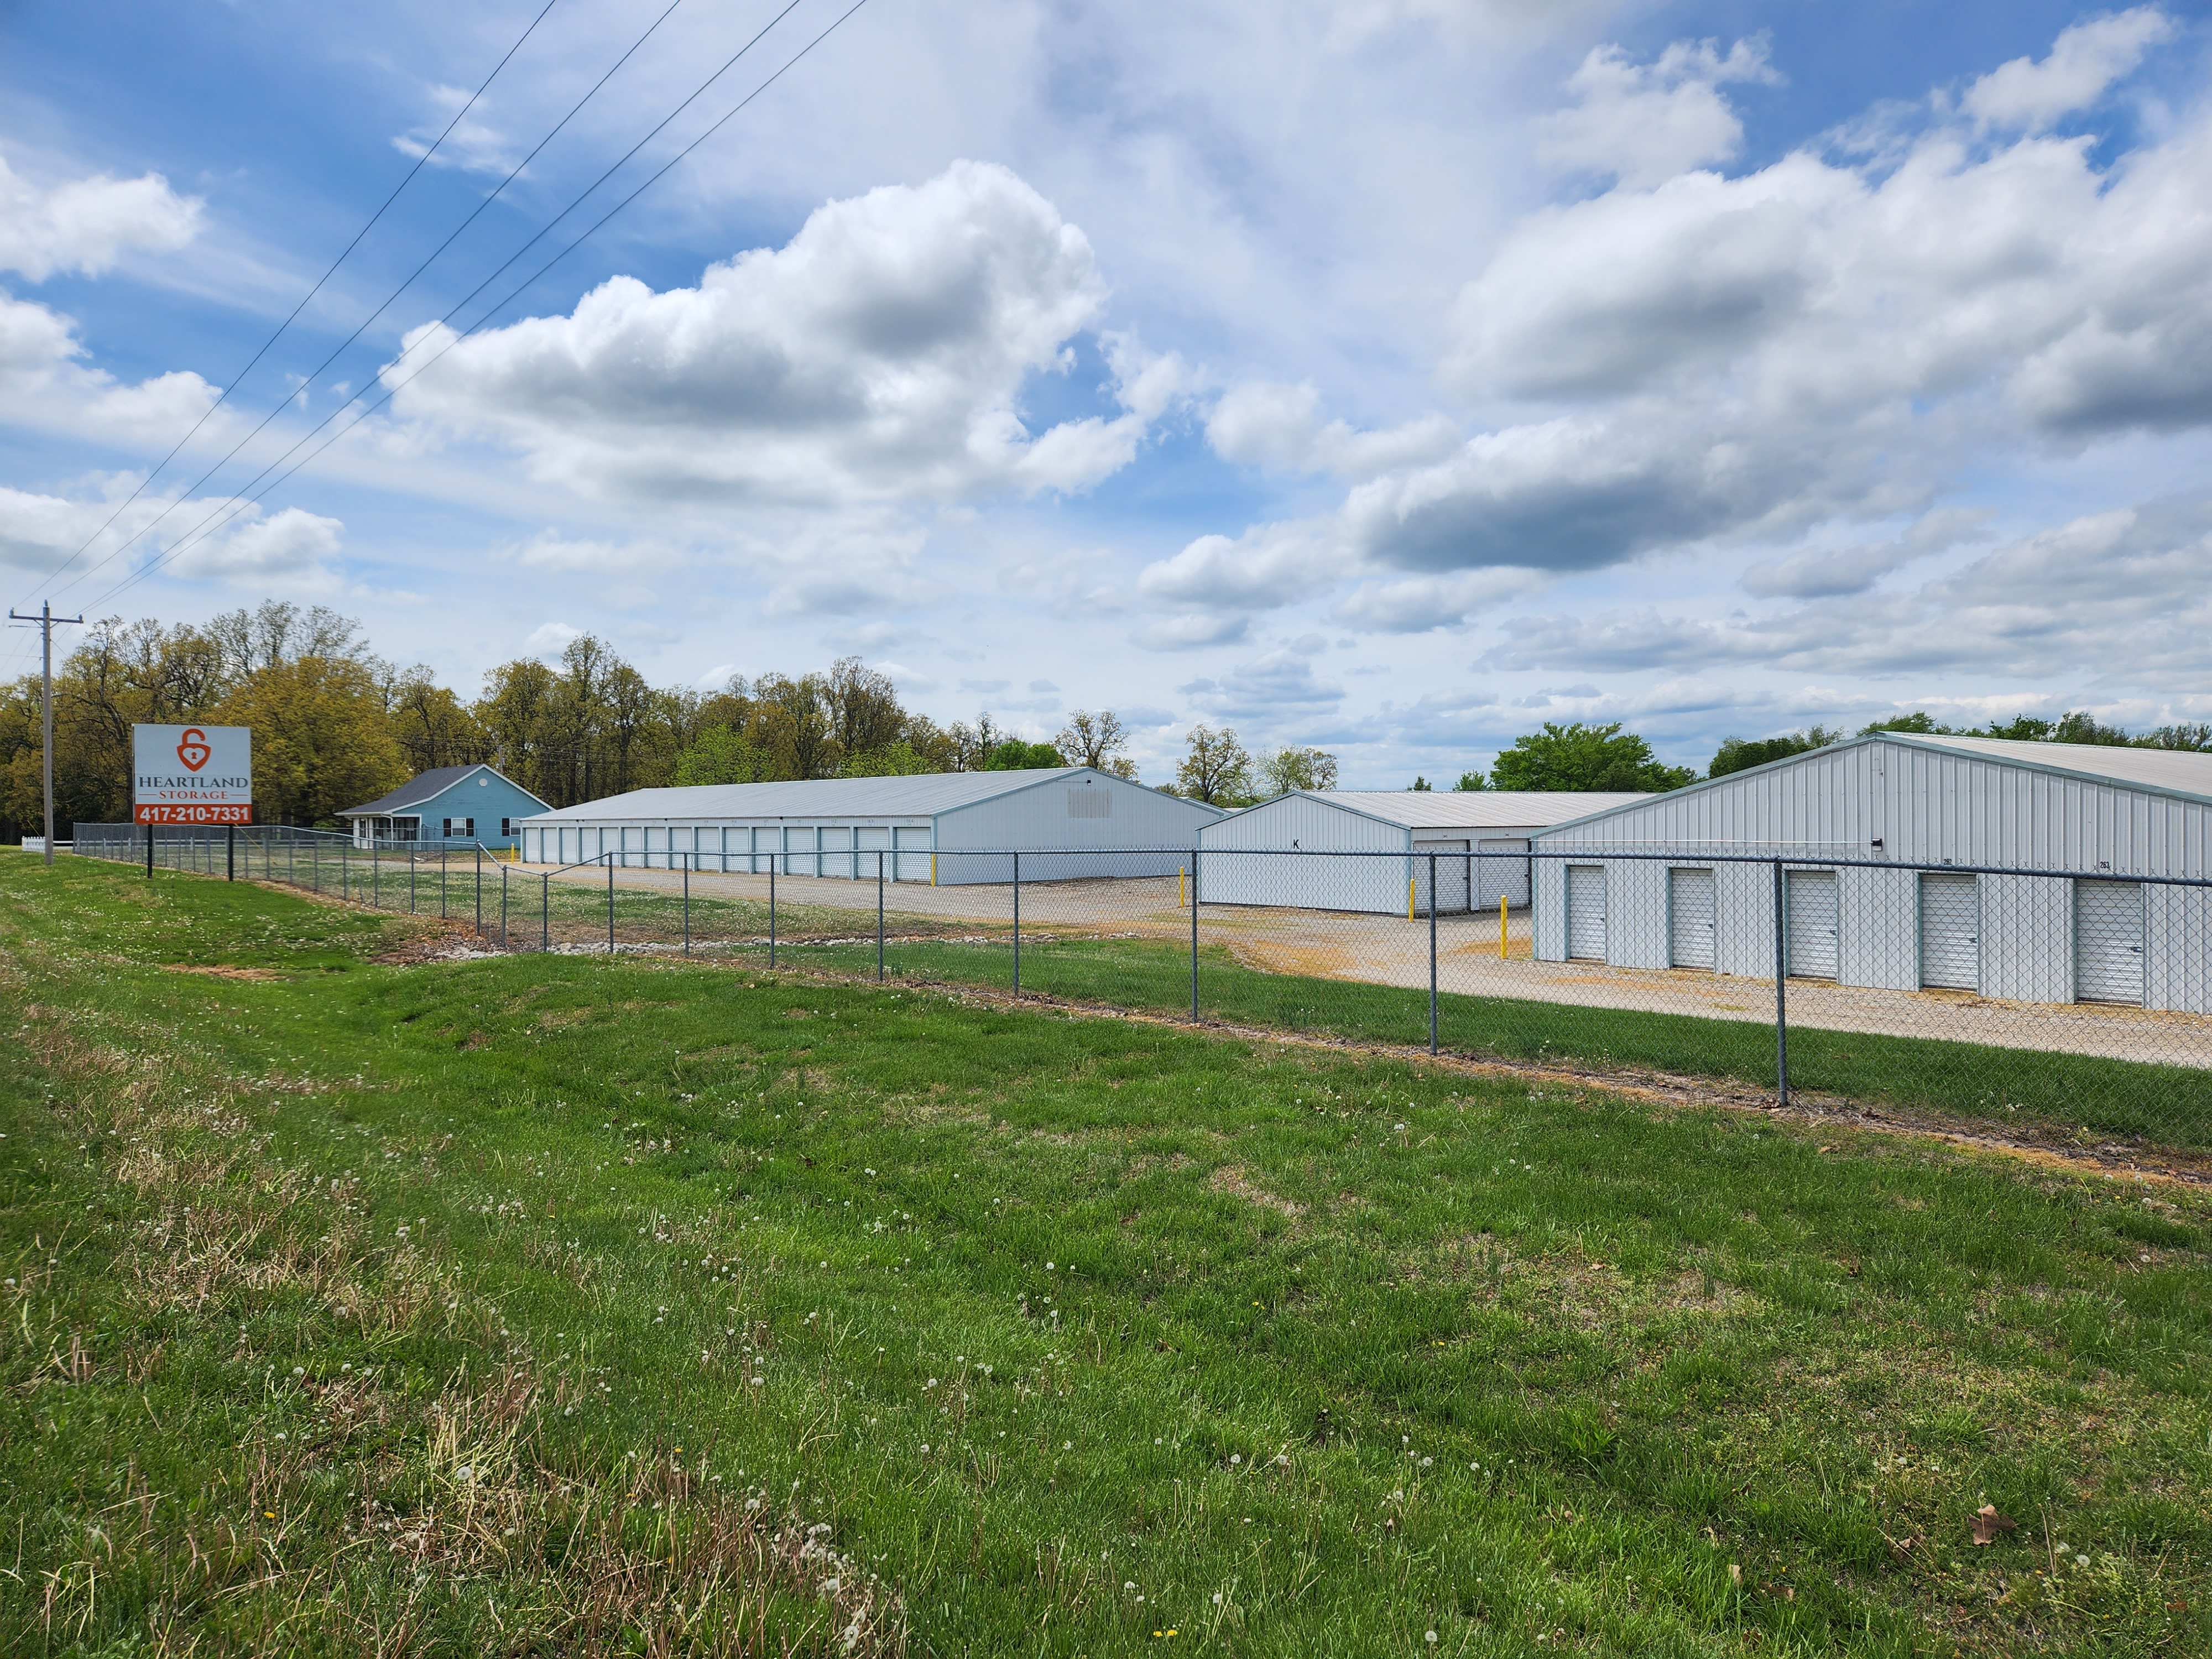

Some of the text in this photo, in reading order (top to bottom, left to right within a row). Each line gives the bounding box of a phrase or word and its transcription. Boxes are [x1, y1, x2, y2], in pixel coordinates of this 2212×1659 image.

[139, 776, 248, 788] HEARTLAND
[159, 791, 228, 799] STORAGE
[140, 807, 248, 821] 417-210-7331
[1293, 839, 1300, 849] K
